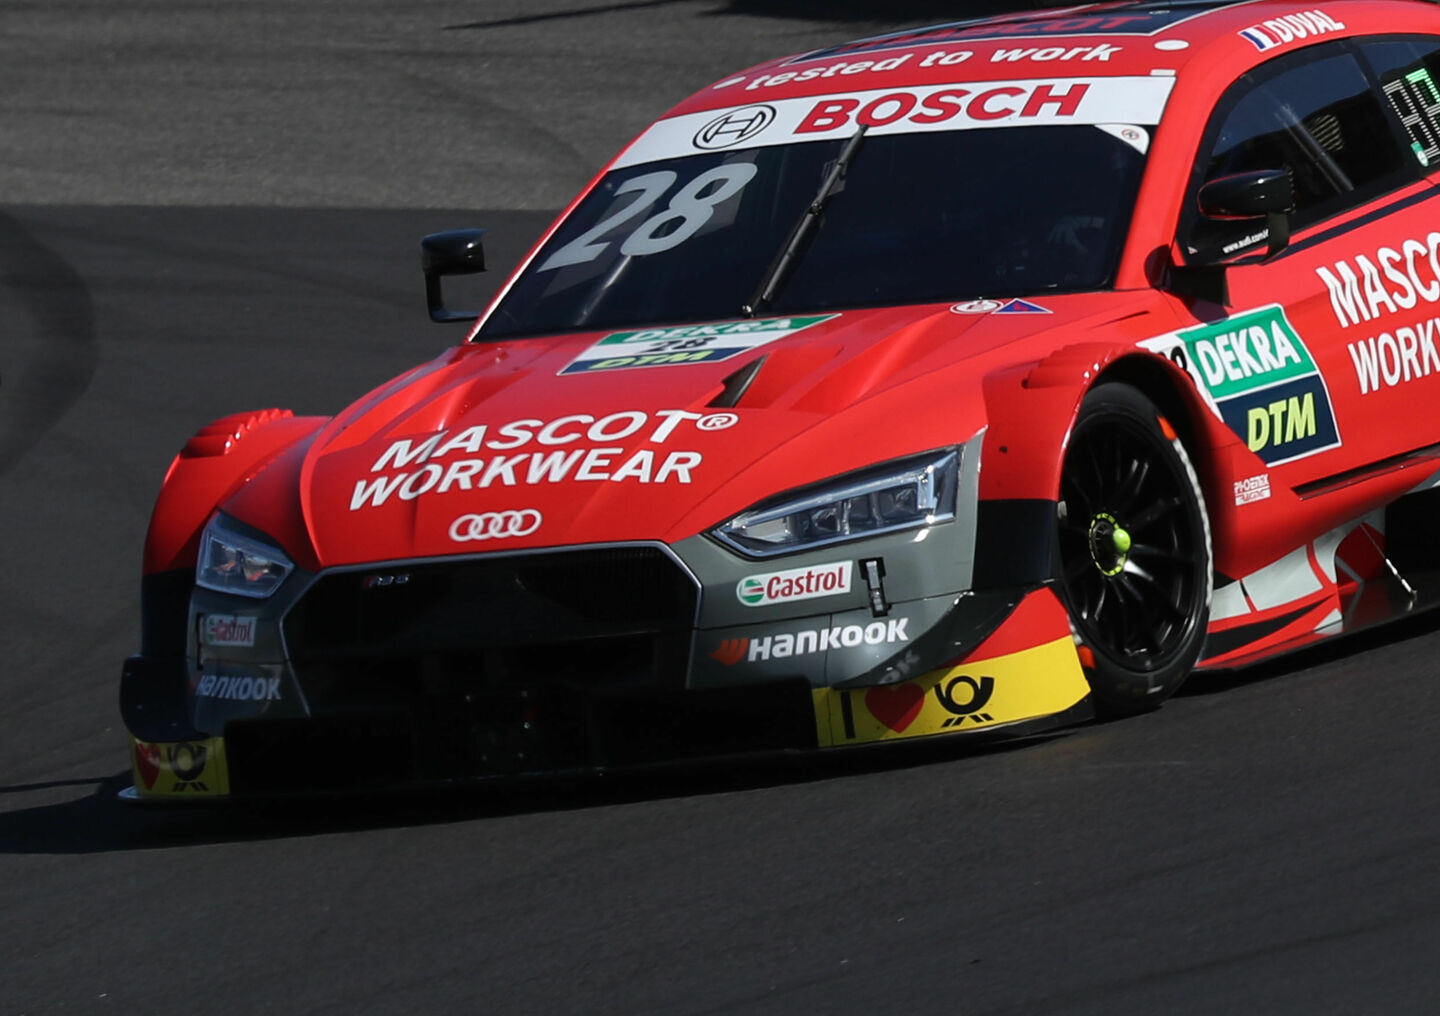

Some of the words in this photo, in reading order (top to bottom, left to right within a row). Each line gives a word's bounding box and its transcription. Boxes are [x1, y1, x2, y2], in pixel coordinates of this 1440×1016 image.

[1265, 10, 1346, 44] DUVAL
[746, 53, 912, 91] tested
[919, 48, 966, 68] to
[990, 42, 1124, 65] work
[794, 83, 1092, 135] BOSCH
[536, 162, 758, 274] 28
[624, 318, 793, 343] DEKRA
[1195, 320, 1302, 387] DEKRA
[588, 350, 715, 370] DTM
[1247, 392, 1317, 453] DTM
[349, 448, 703, 512] WORKWEAR
[766, 566, 846, 601] Castrol
